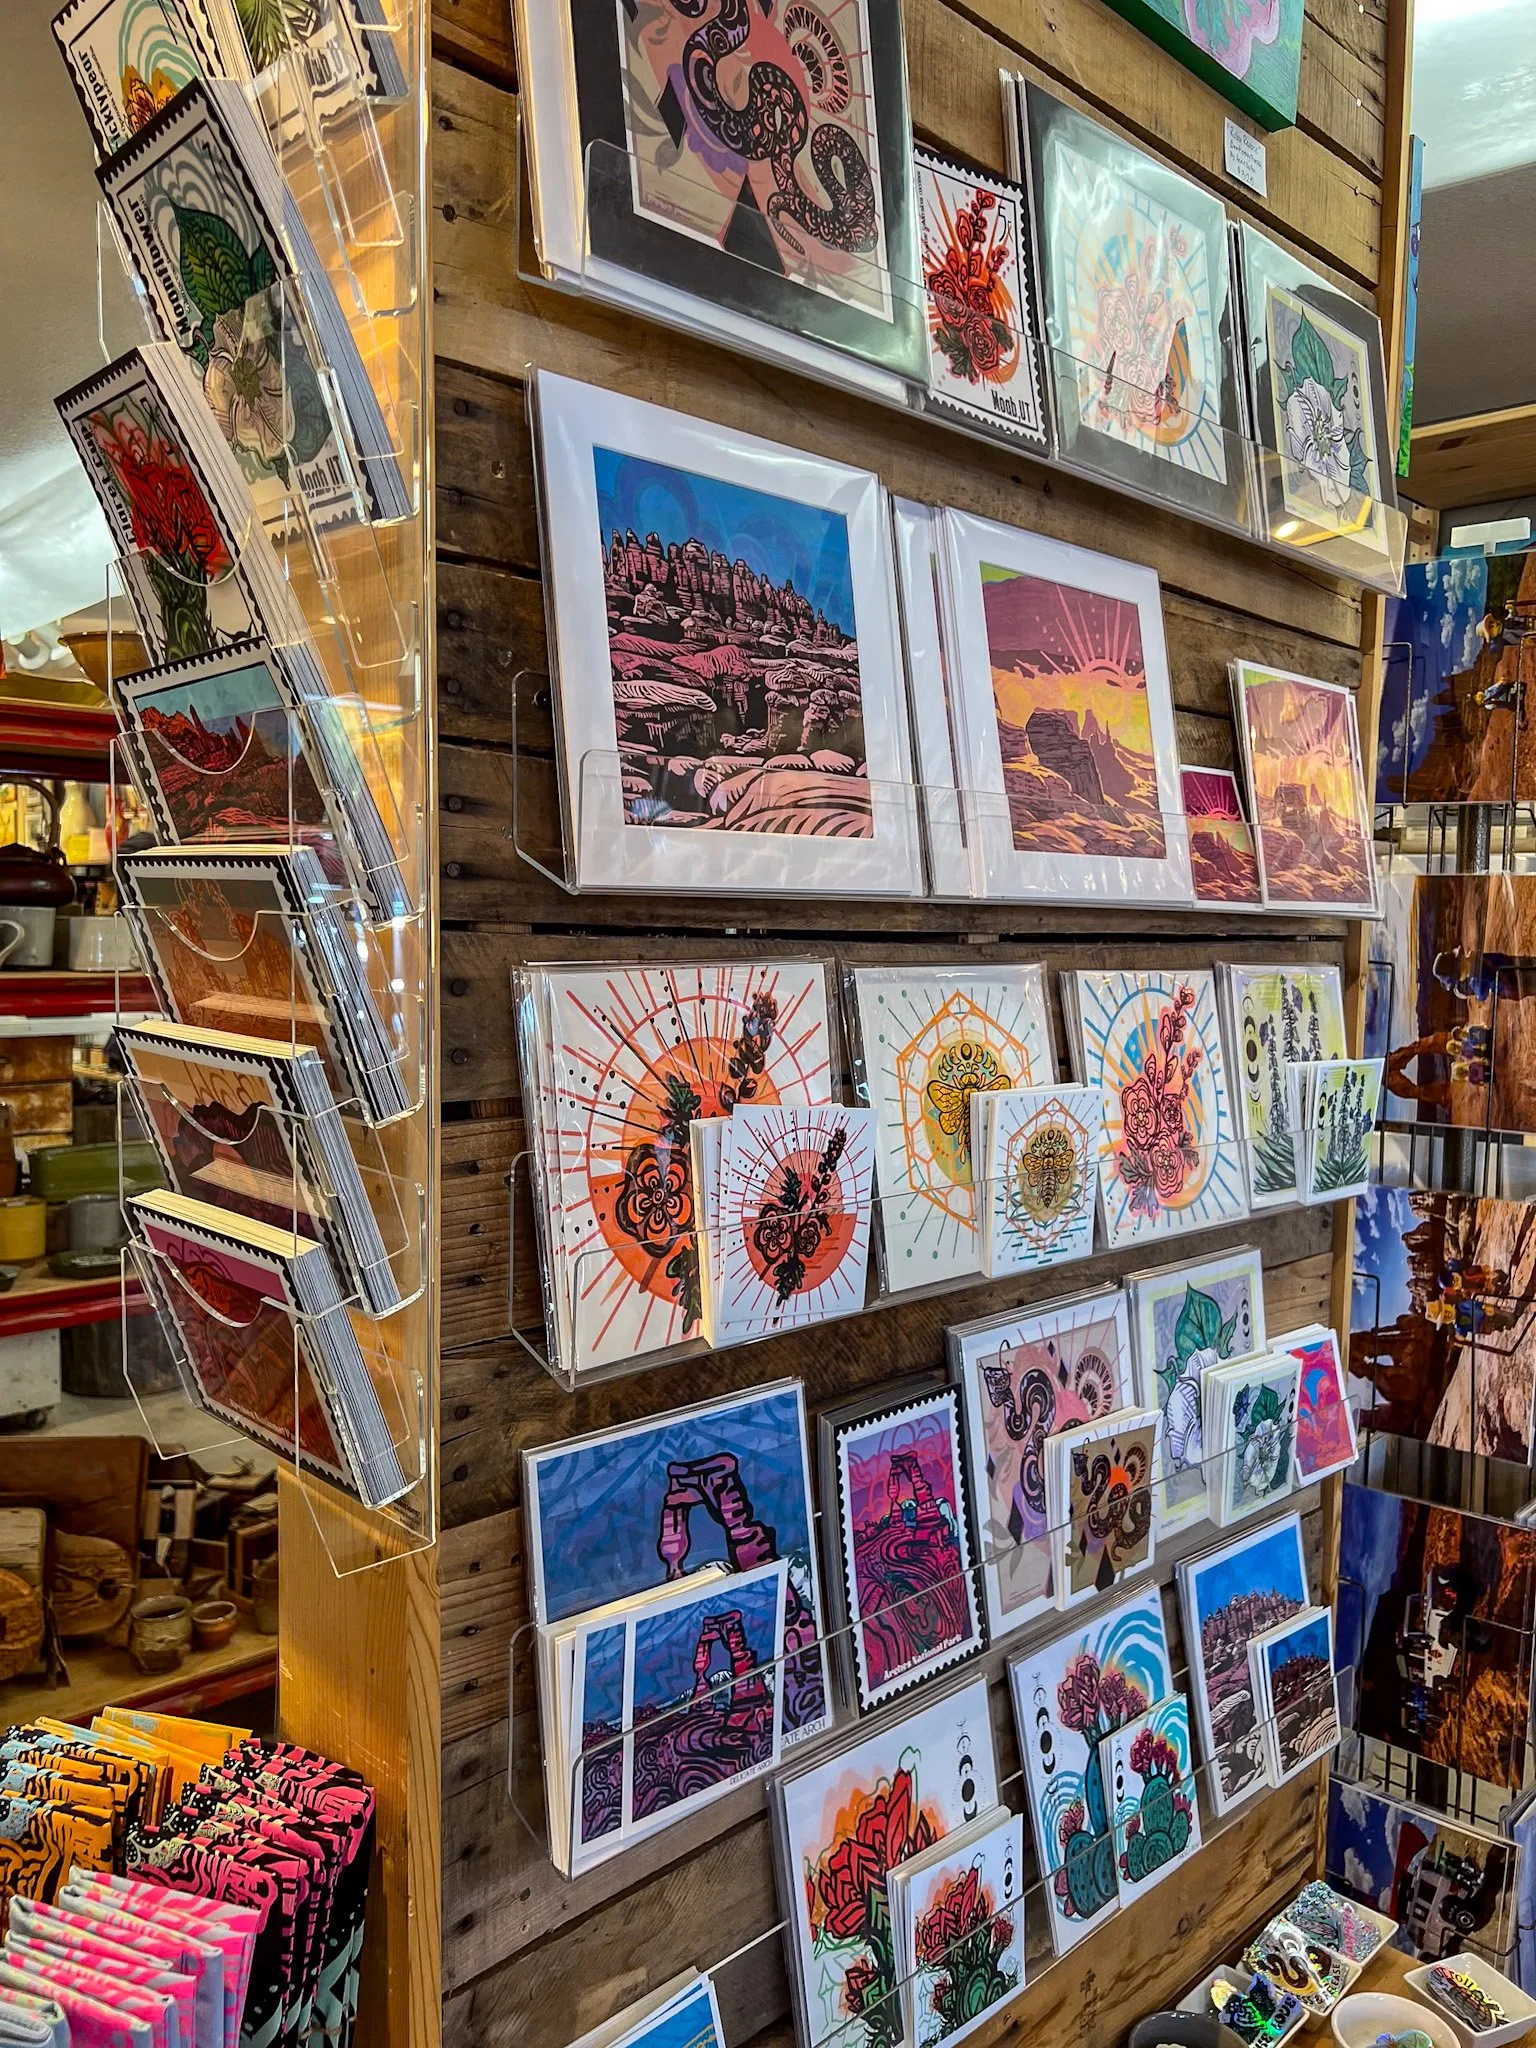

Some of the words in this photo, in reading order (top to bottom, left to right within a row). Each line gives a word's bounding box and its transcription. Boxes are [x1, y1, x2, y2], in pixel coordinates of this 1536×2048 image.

[127, 198, 192, 336] Moonflower
[81, 426, 104, 468] Cup
[101, 472, 136, 543] Claret
[912, 1642, 943, 1665] National
[943, 1633, 963, 1650] Park
[801, 1717, 826, 1737] ARCH
[729, 1766, 757, 1786] DELICATE
[757, 1758, 773, 1772] ARCH
